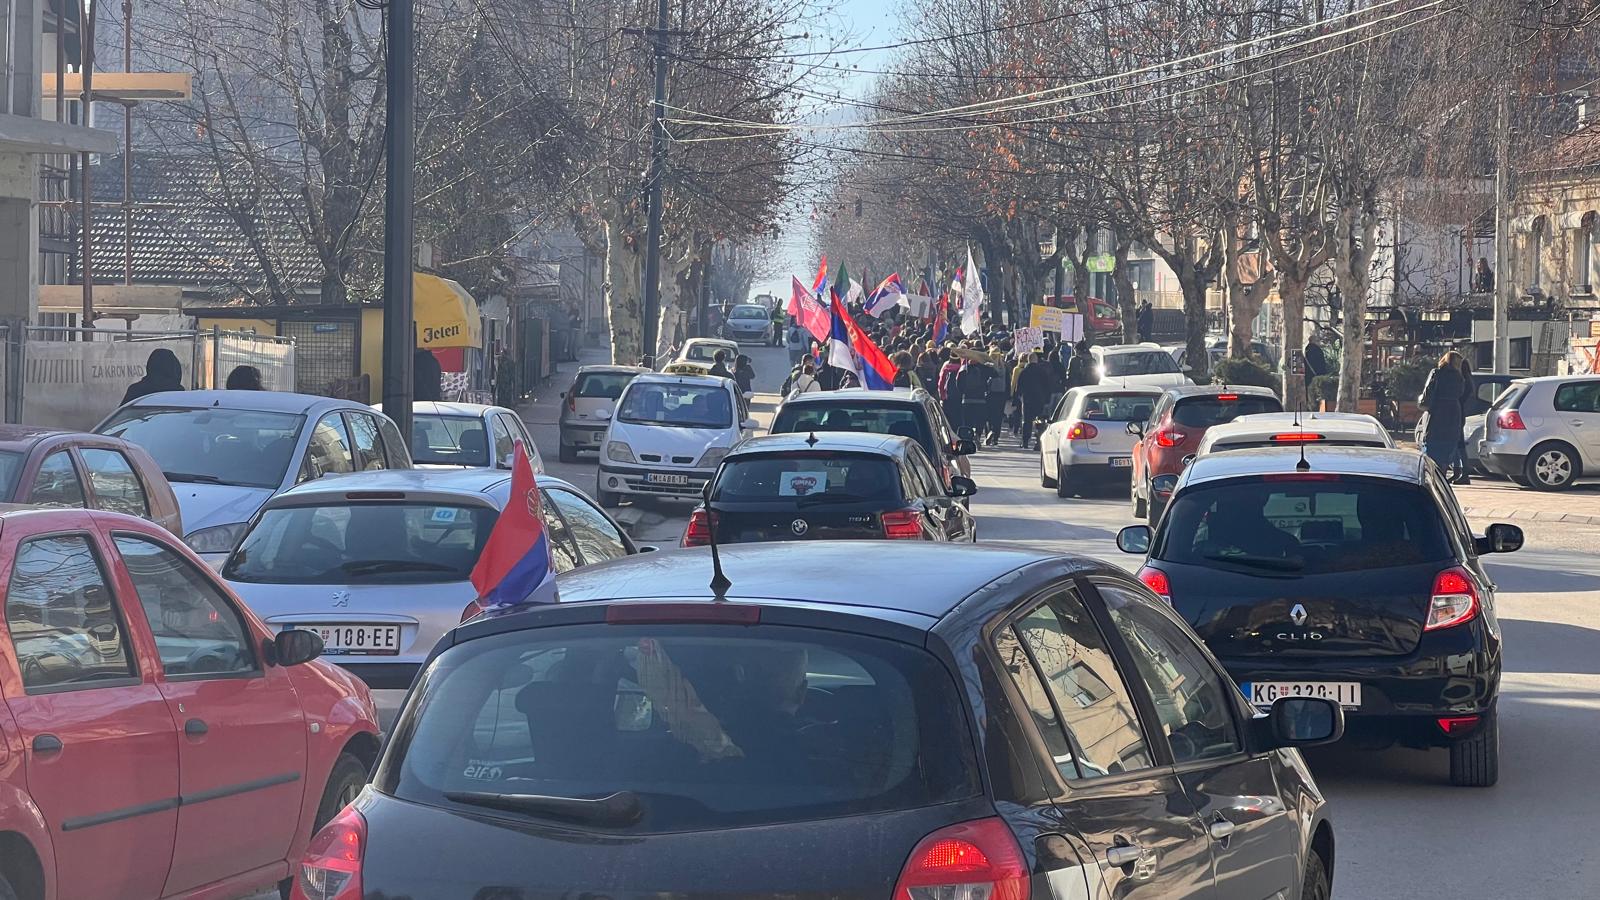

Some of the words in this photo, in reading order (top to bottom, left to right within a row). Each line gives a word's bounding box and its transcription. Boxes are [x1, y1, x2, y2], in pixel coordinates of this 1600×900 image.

[423, 325, 459, 343] Jelen
[92, 366, 104, 378] ZA
[105, 366, 126, 377] KROV
[127, 365, 144, 377] NAD
[1276, 632, 1323, 640] CLIO
[1254, 684, 1277, 703] KG
[463, 766, 490, 778] elf
